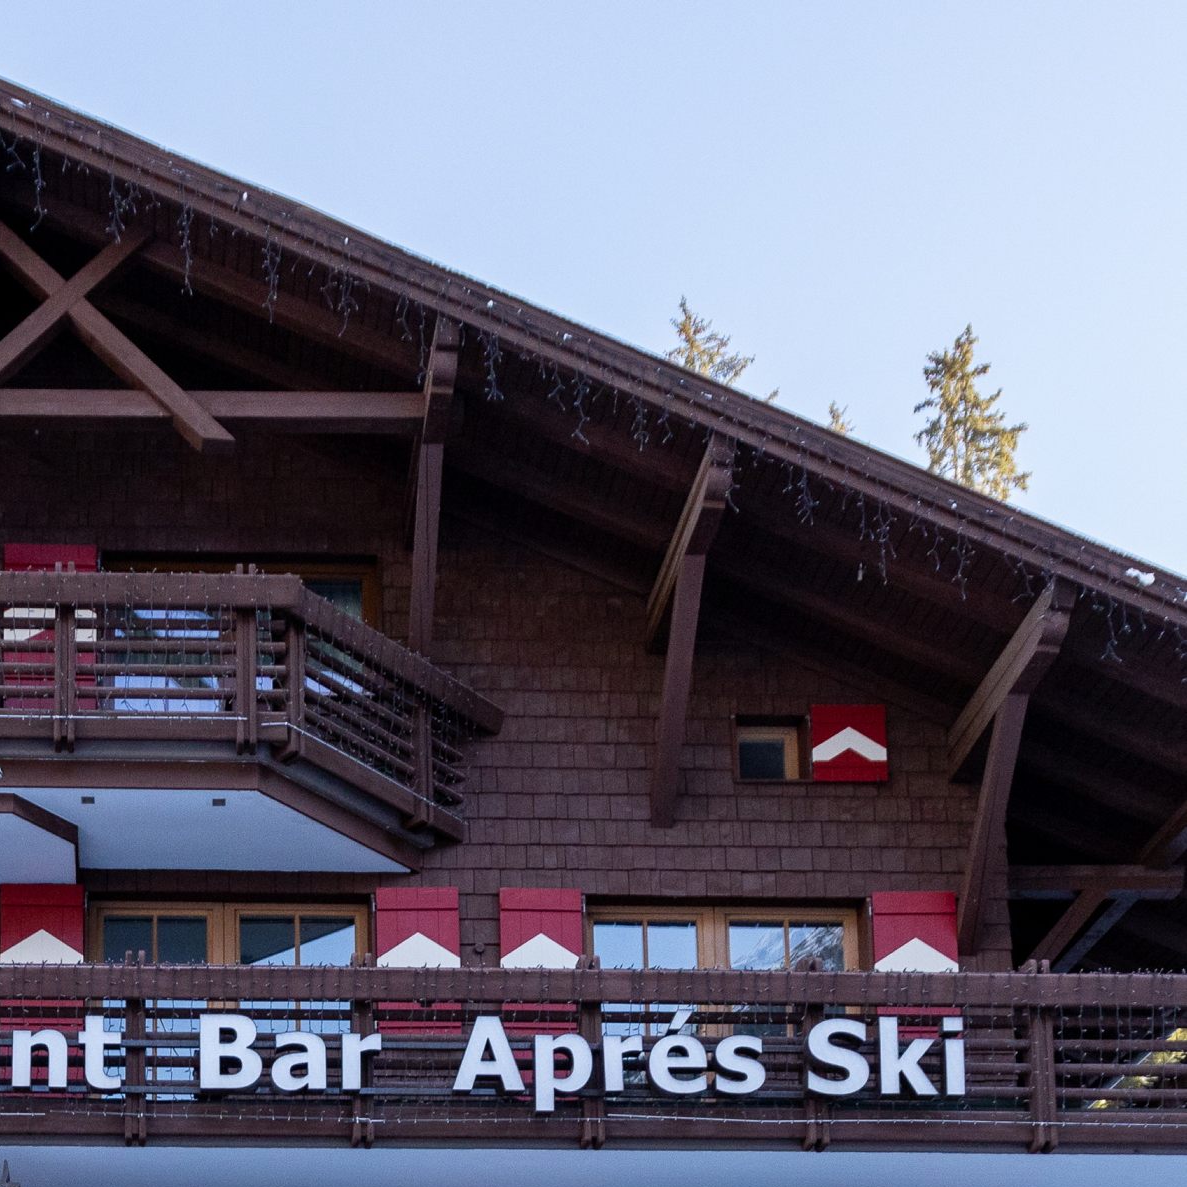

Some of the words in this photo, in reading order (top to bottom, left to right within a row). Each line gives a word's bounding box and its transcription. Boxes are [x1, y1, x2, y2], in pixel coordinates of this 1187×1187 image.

[197, 1012, 383, 1094] Bar
[452, 1008, 767, 1114] Aprés
[805, 1015, 968, 1098] Ski
